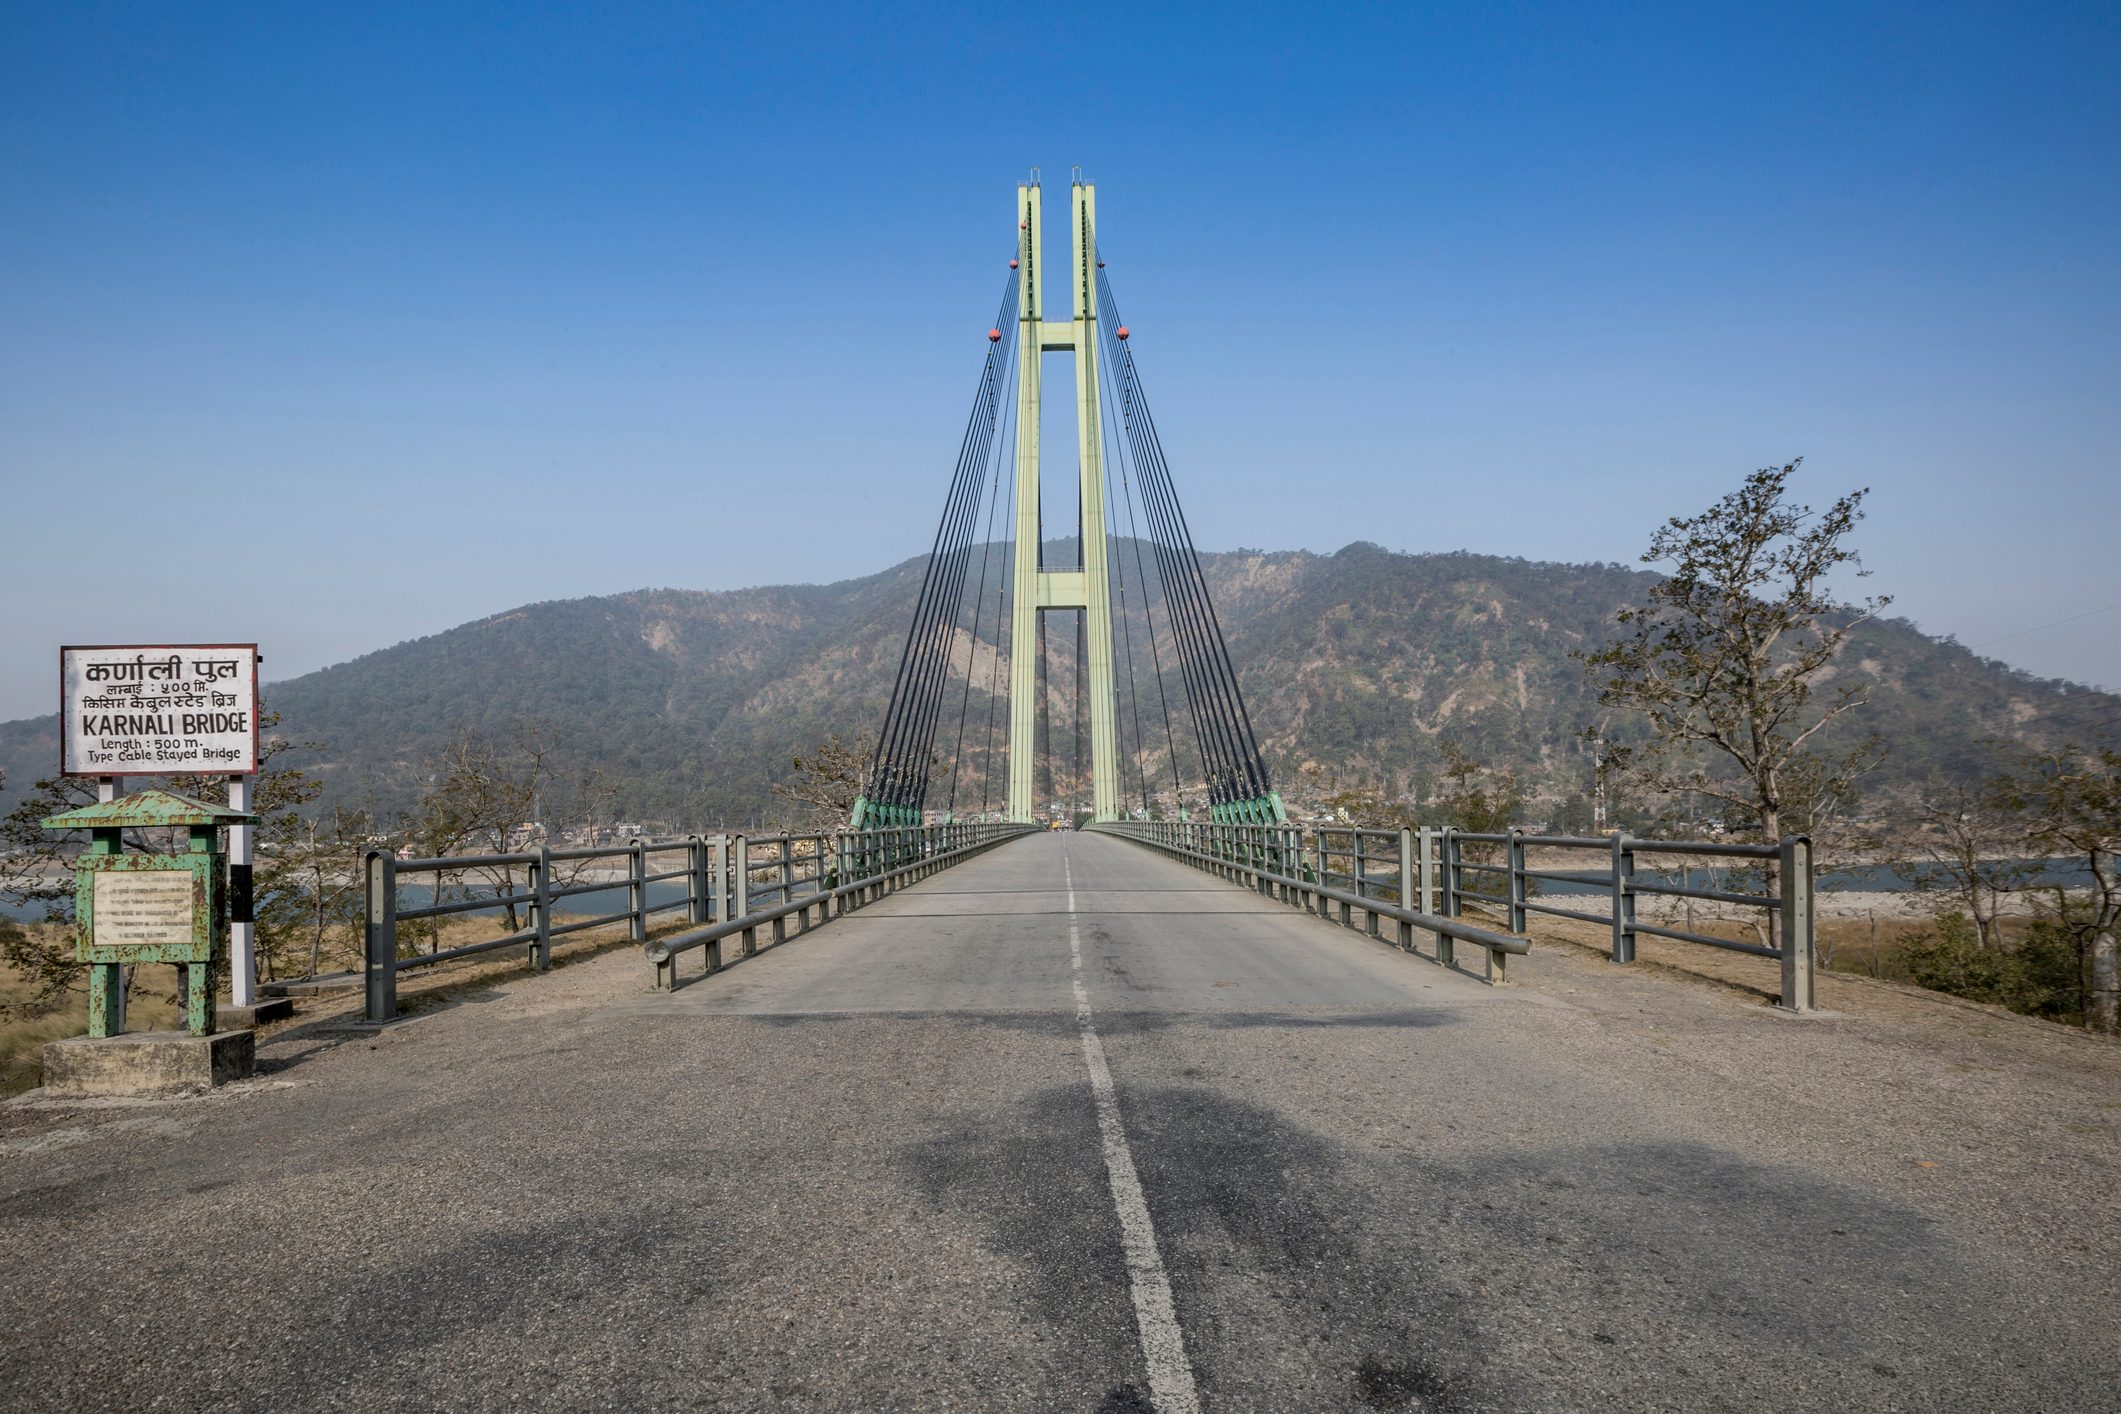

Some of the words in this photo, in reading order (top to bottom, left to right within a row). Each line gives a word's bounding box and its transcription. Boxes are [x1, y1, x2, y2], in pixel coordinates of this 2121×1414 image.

[86, 654, 182, 681] कर्णाली
[192, 660, 239, 682] पुल
[107, 681, 143, 695] लम्बाई
[161, 682, 190, 693] ५००
[82, 695, 126, 709] किसिम
[211, 690, 237, 708] ब्रिज
[83, 714, 174, 736] KARNALI
[182, 712, 248, 735] BRIDGE
[101, 738, 142, 752] Length
[154, 739, 181, 749] 500
[88, 750, 113, 763] Type
[118, 749, 152, 762] Cable
[156, 749, 198, 762] Stayed
[203, 748, 241, 761] Bridge
